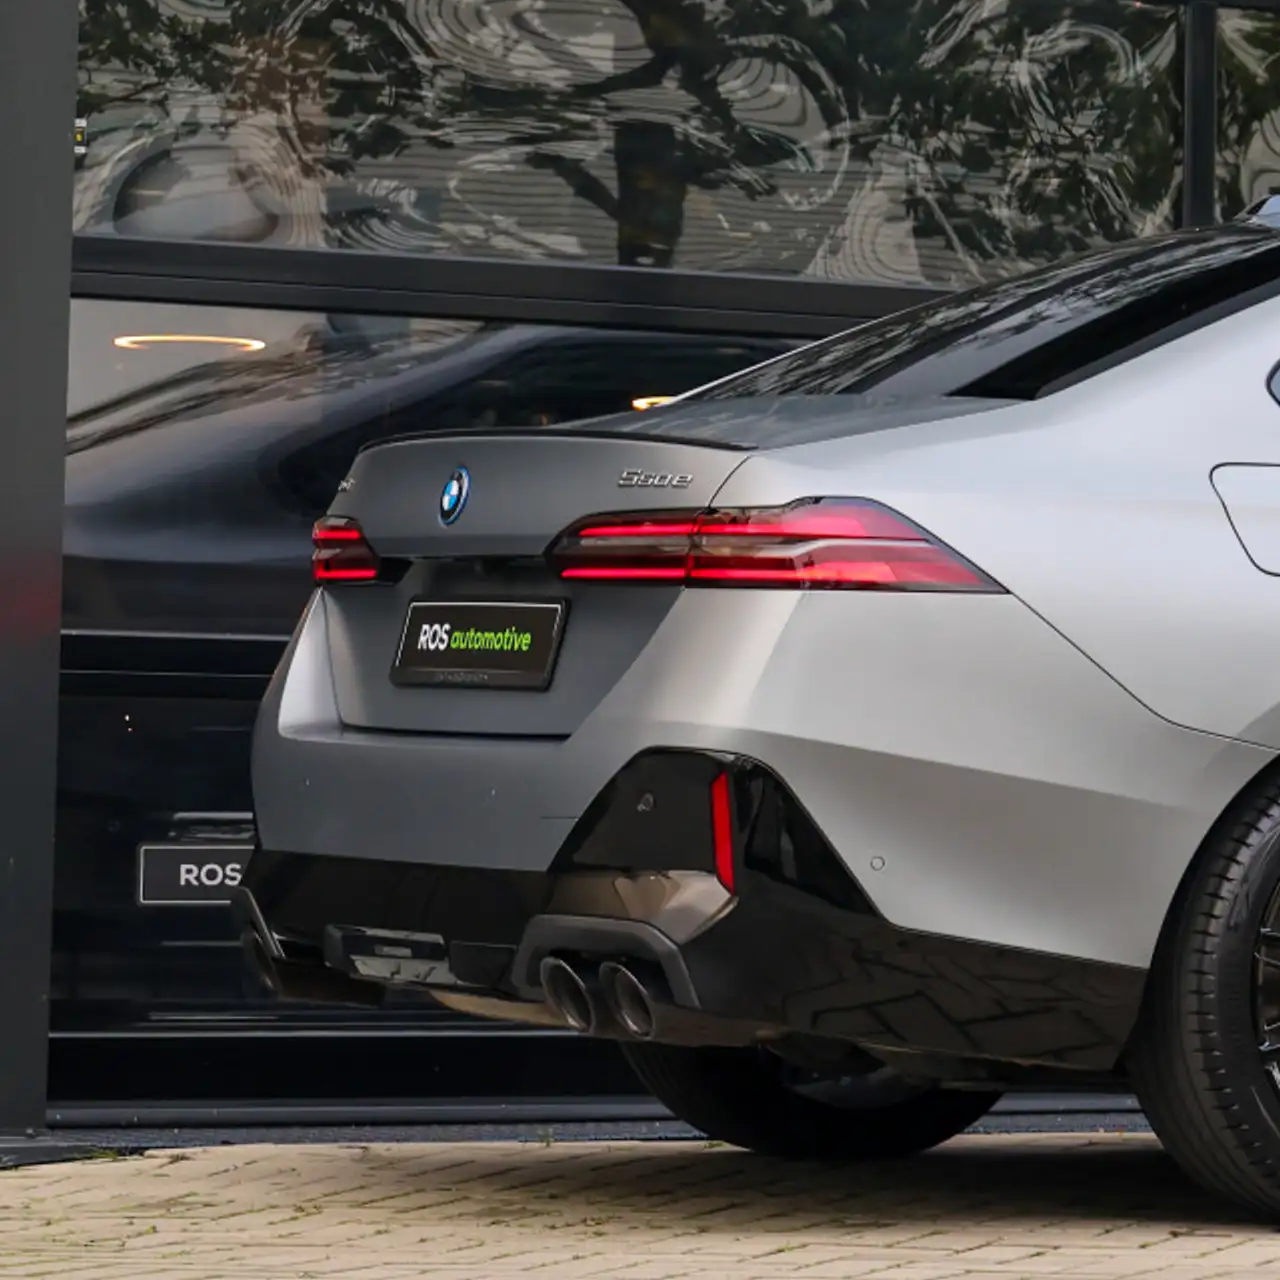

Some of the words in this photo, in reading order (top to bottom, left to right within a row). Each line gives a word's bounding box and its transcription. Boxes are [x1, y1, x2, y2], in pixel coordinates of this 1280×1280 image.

[417, 622, 450, 651] ROS
[450, 626, 531, 652] automotive
[179, 863, 242, 886] ROS
